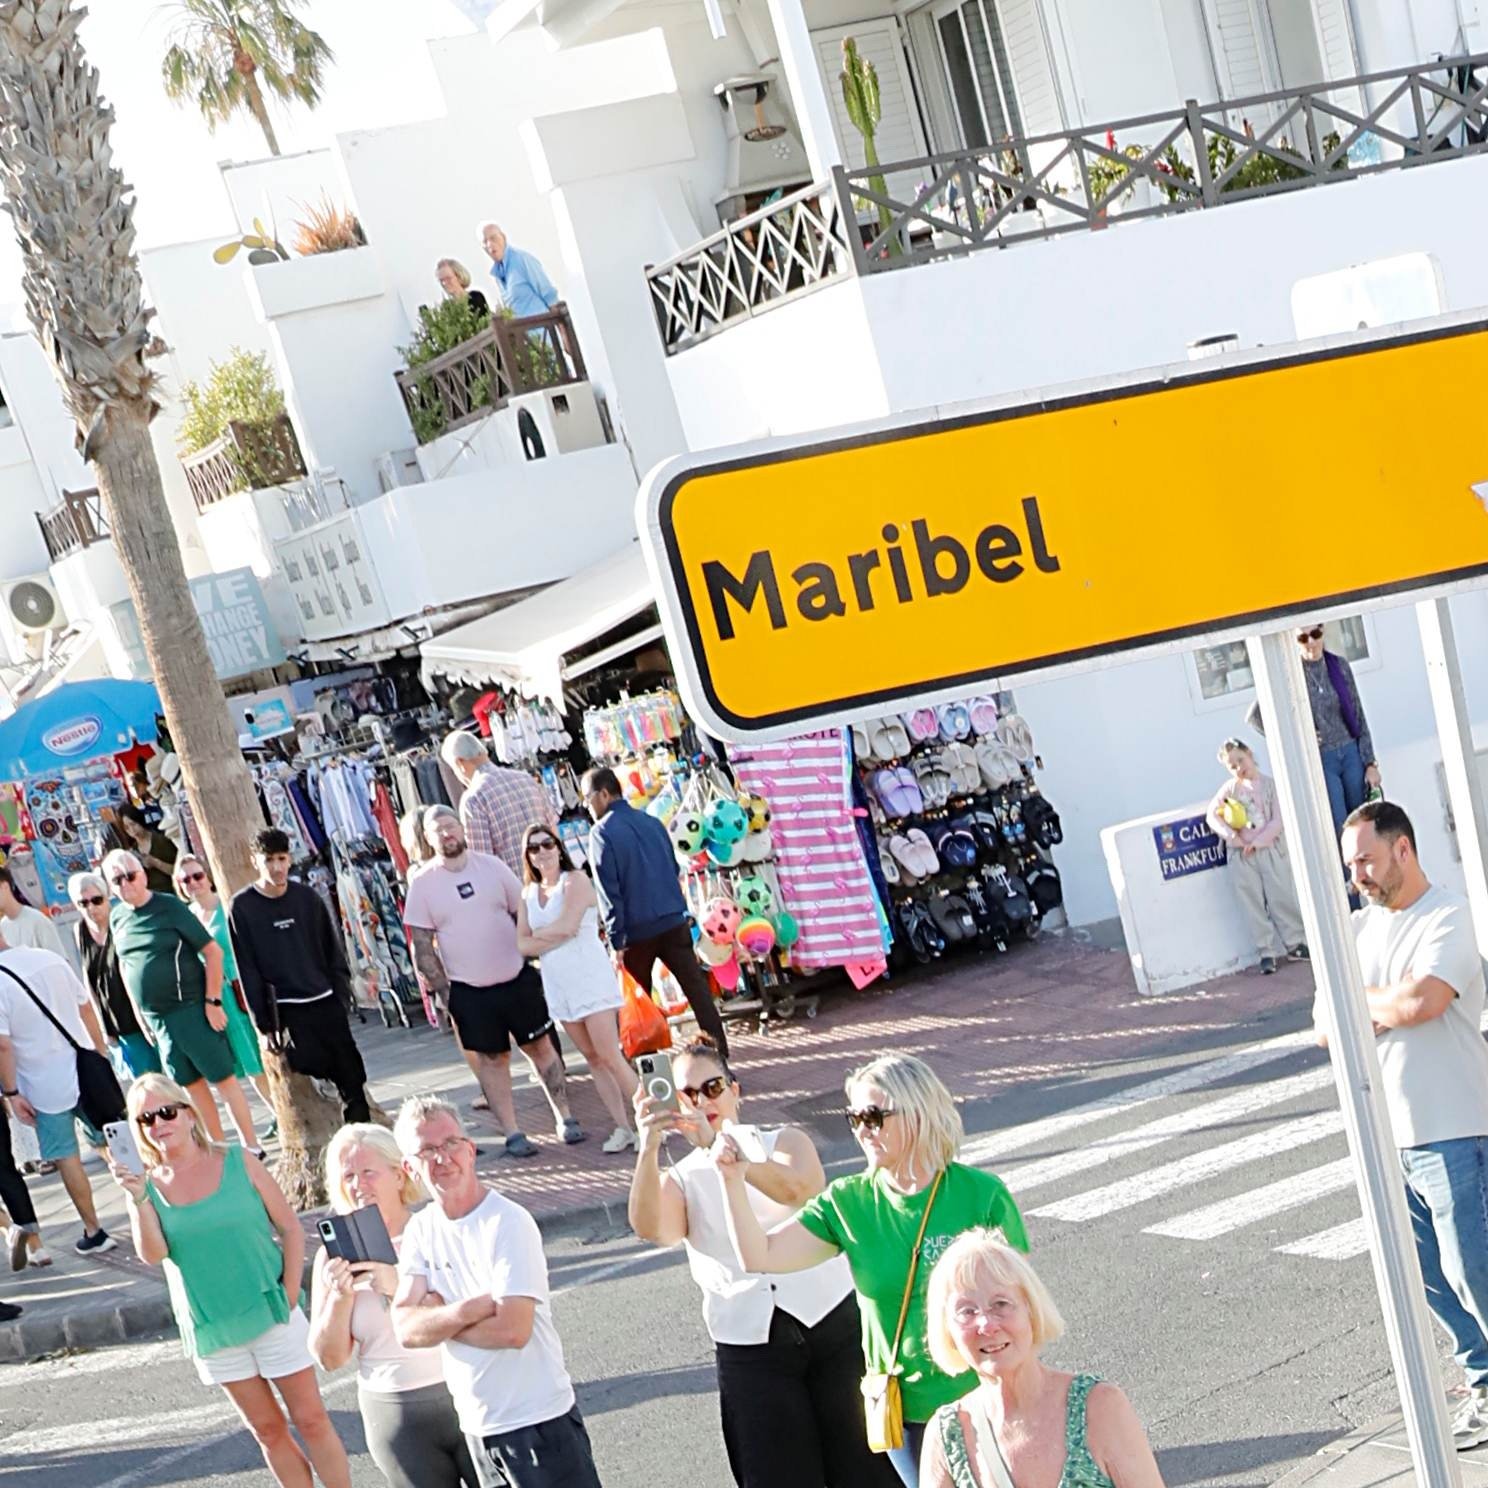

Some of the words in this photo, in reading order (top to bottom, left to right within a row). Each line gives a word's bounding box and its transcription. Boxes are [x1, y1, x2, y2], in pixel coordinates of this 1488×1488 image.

[702, 496, 1061, 641] Maribel
[202, 602, 263, 639] HANGE
[1179, 821, 1214, 842] CAL
